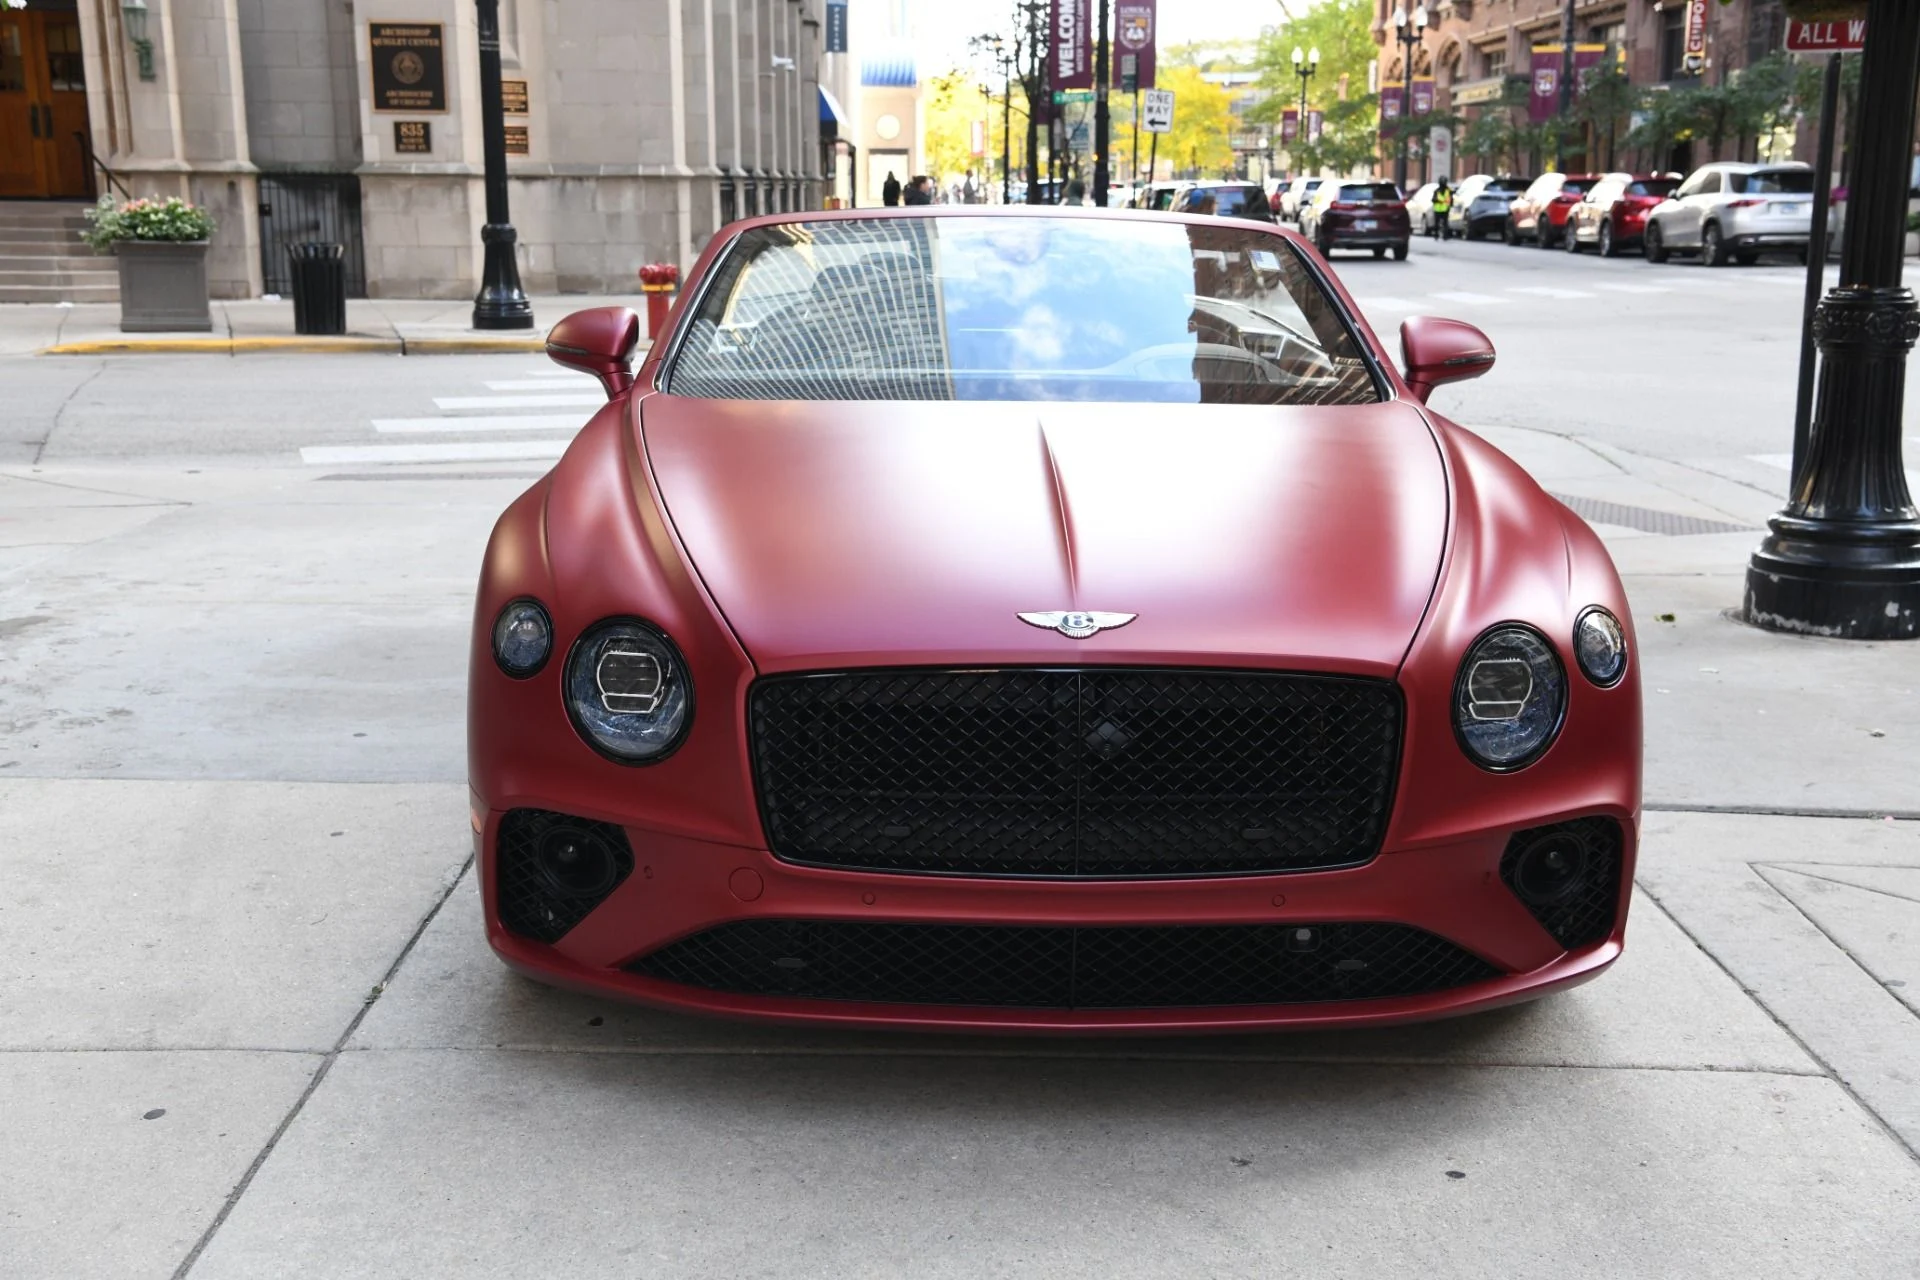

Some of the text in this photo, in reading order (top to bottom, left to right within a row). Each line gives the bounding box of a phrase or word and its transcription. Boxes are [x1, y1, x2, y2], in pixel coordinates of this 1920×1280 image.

[1119, 6, 1151, 15] LOYOLA
[1690, 0, 1705, 50] CHIPO
[1797, 20, 1865, 43] ALL W
[1076, 22, 1084, 46] TOWER
[408, 37, 440, 47] CENTER
[1076, 48, 1084, 73] WATER
[1147, 93, 1171, 104] ONE
[1147, 106, 1169, 115] WAY
[400, 123, 424, 136] 835
